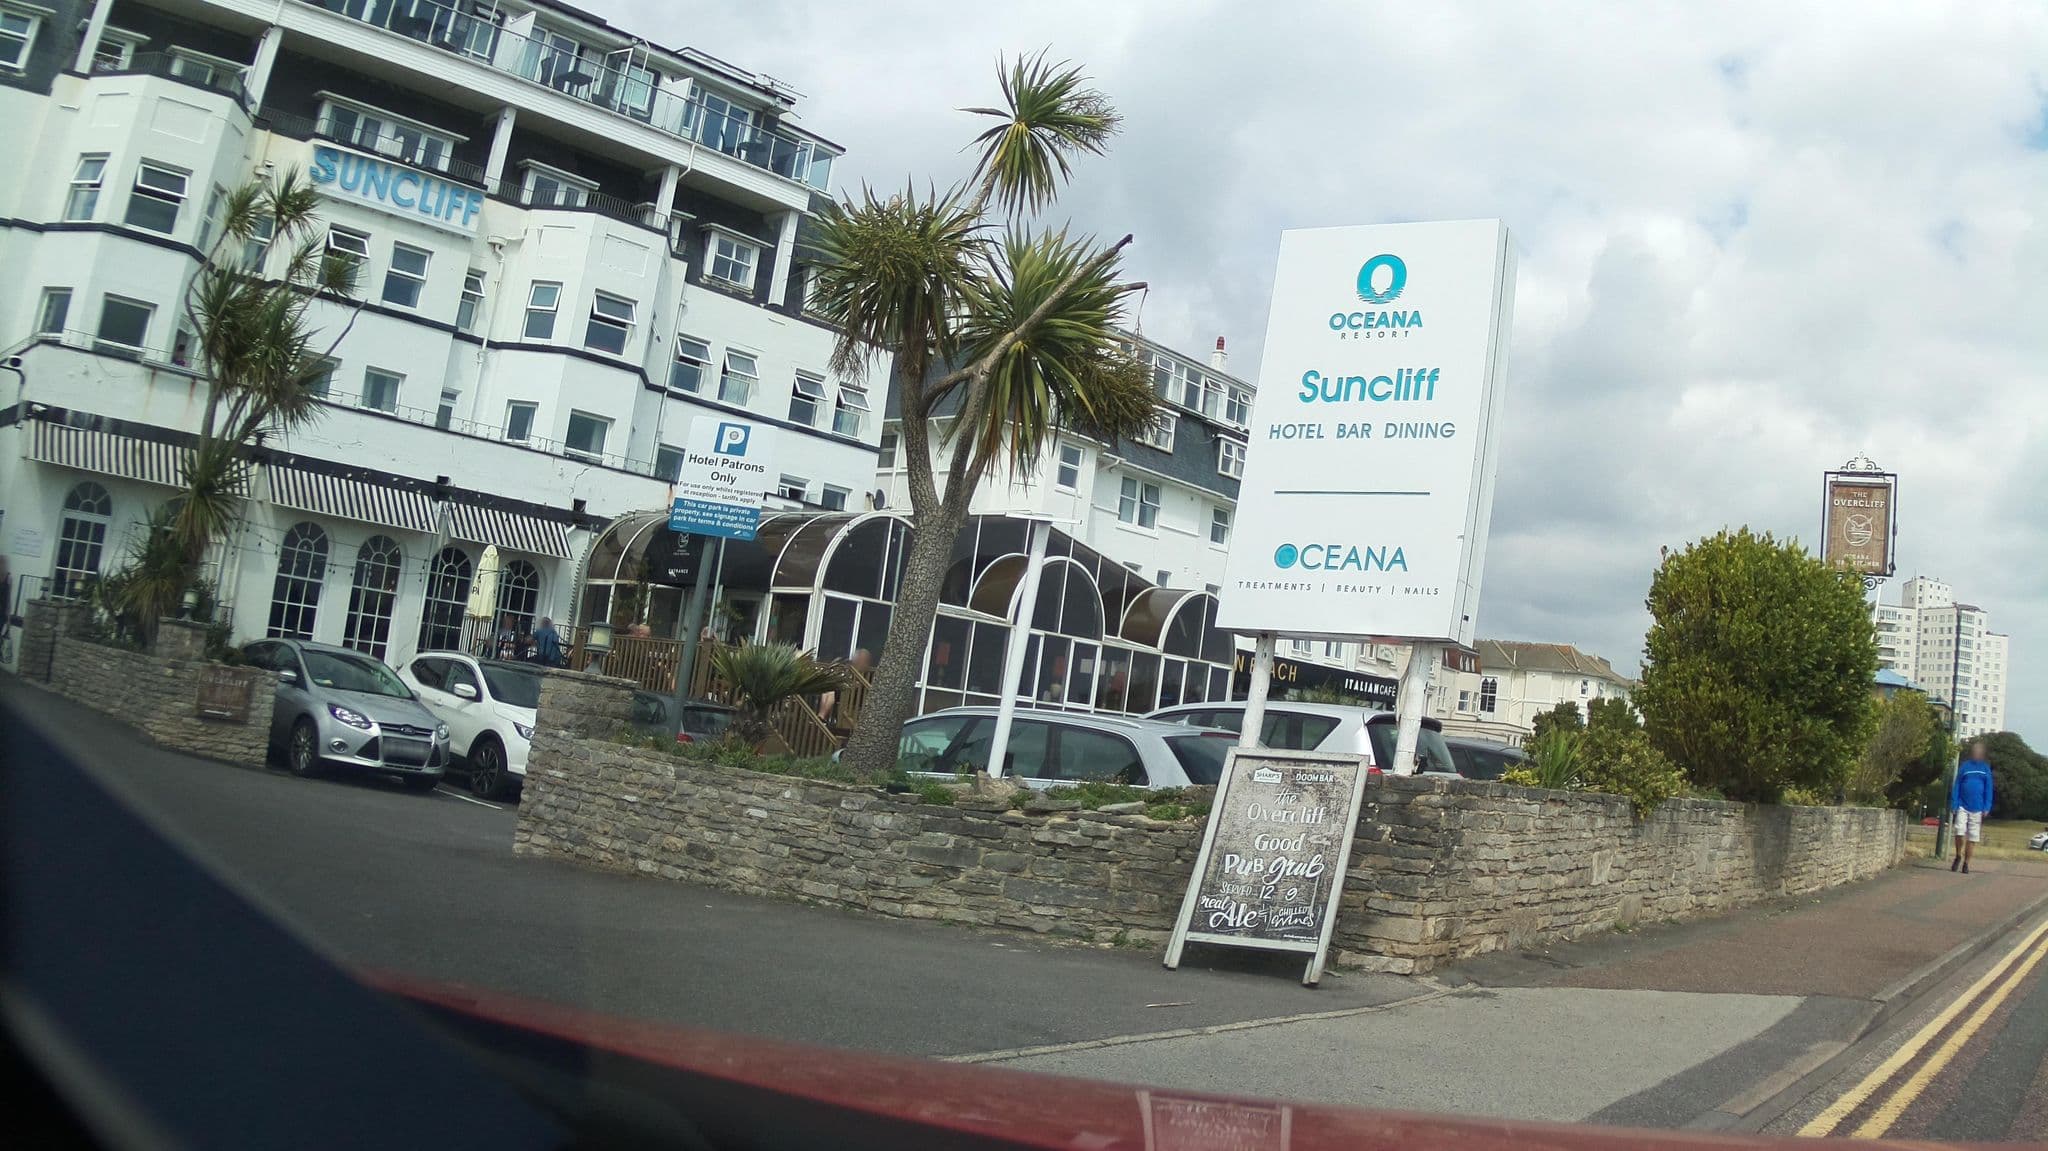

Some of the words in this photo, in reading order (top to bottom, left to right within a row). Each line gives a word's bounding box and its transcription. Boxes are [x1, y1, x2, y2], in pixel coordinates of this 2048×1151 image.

[310, 150, 485, 226] SUNCLIFF
[1329, 310, 1423, 331] OCEANA
[1340, 330, 1409, 340] RESORT
[1298, 367, 1441, 404] Suncliff
[1268, 424, 1325, 440] HOTEL
[1336, 423, 1373, 440] BAR
[1384, 422, 1456, 439] DINING
[688, 453, 718, 467] Hotel
[721, 457, 766, 473] Patrons
[710, 471, 738, 486] Only
[690, 490, 718, 500] reception
[740, 497, 756, 505] apply
[702, 484, 715, 492] only
[716, 486, 733, 494] whilst
[733, 488, 763, 498] registered
[708, 504, 722, 512] park
[729, 506, 751, 516] private
[1833, 499, 1886, 509] OVERCLIFF
[673, 514, 687, 523] park
[697, 518, 715, 526] terms
[715, 519, 722, 527] &
[722, 521, 754, 531] conditions
[714, 512, 738, 523] signage
[1273, 543, 1409, 572] OCEANA
[1238, 580, 1313, 592] TREATMENTS
[1336, 584, 1382, 594] BEAUTY
[1404, 586, 1440, 596] NAILS
[1249, 656, 1298, 683] BACH
[1344, 678, 1380, 695] ITALIAN
[1254, 832, 1306, 852] Good
[1259, 884, 1275, 900] 12
[1208, 899, 1260, 928] Ale
